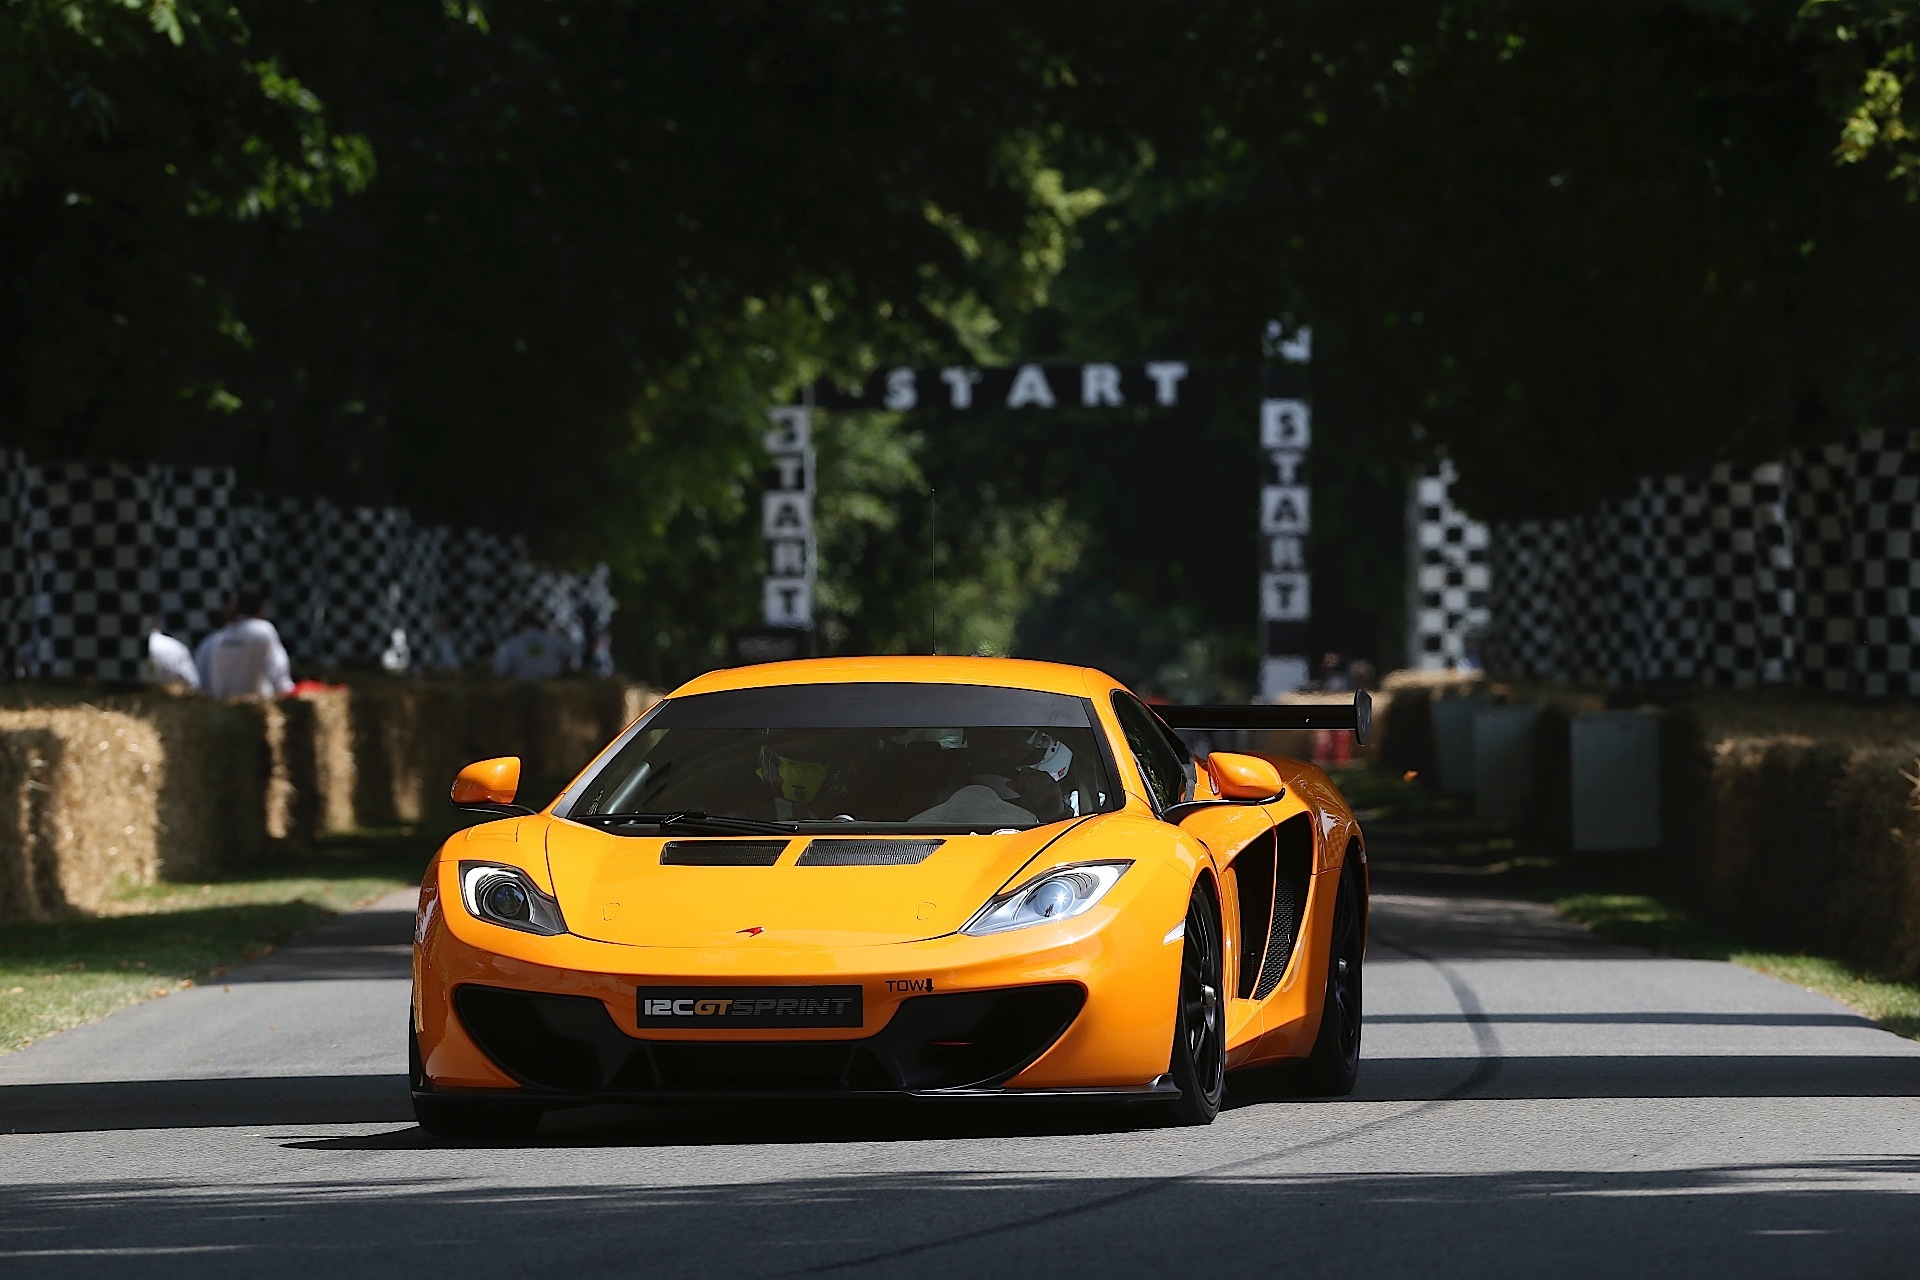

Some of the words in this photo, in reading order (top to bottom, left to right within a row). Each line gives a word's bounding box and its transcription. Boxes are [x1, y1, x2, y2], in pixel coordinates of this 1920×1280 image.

[884, 361, 1188, 410] START
[769, 410, 806, 620] START
[1267, 409, 1305, 612] START
[885, 979, 924, 993] TOW
